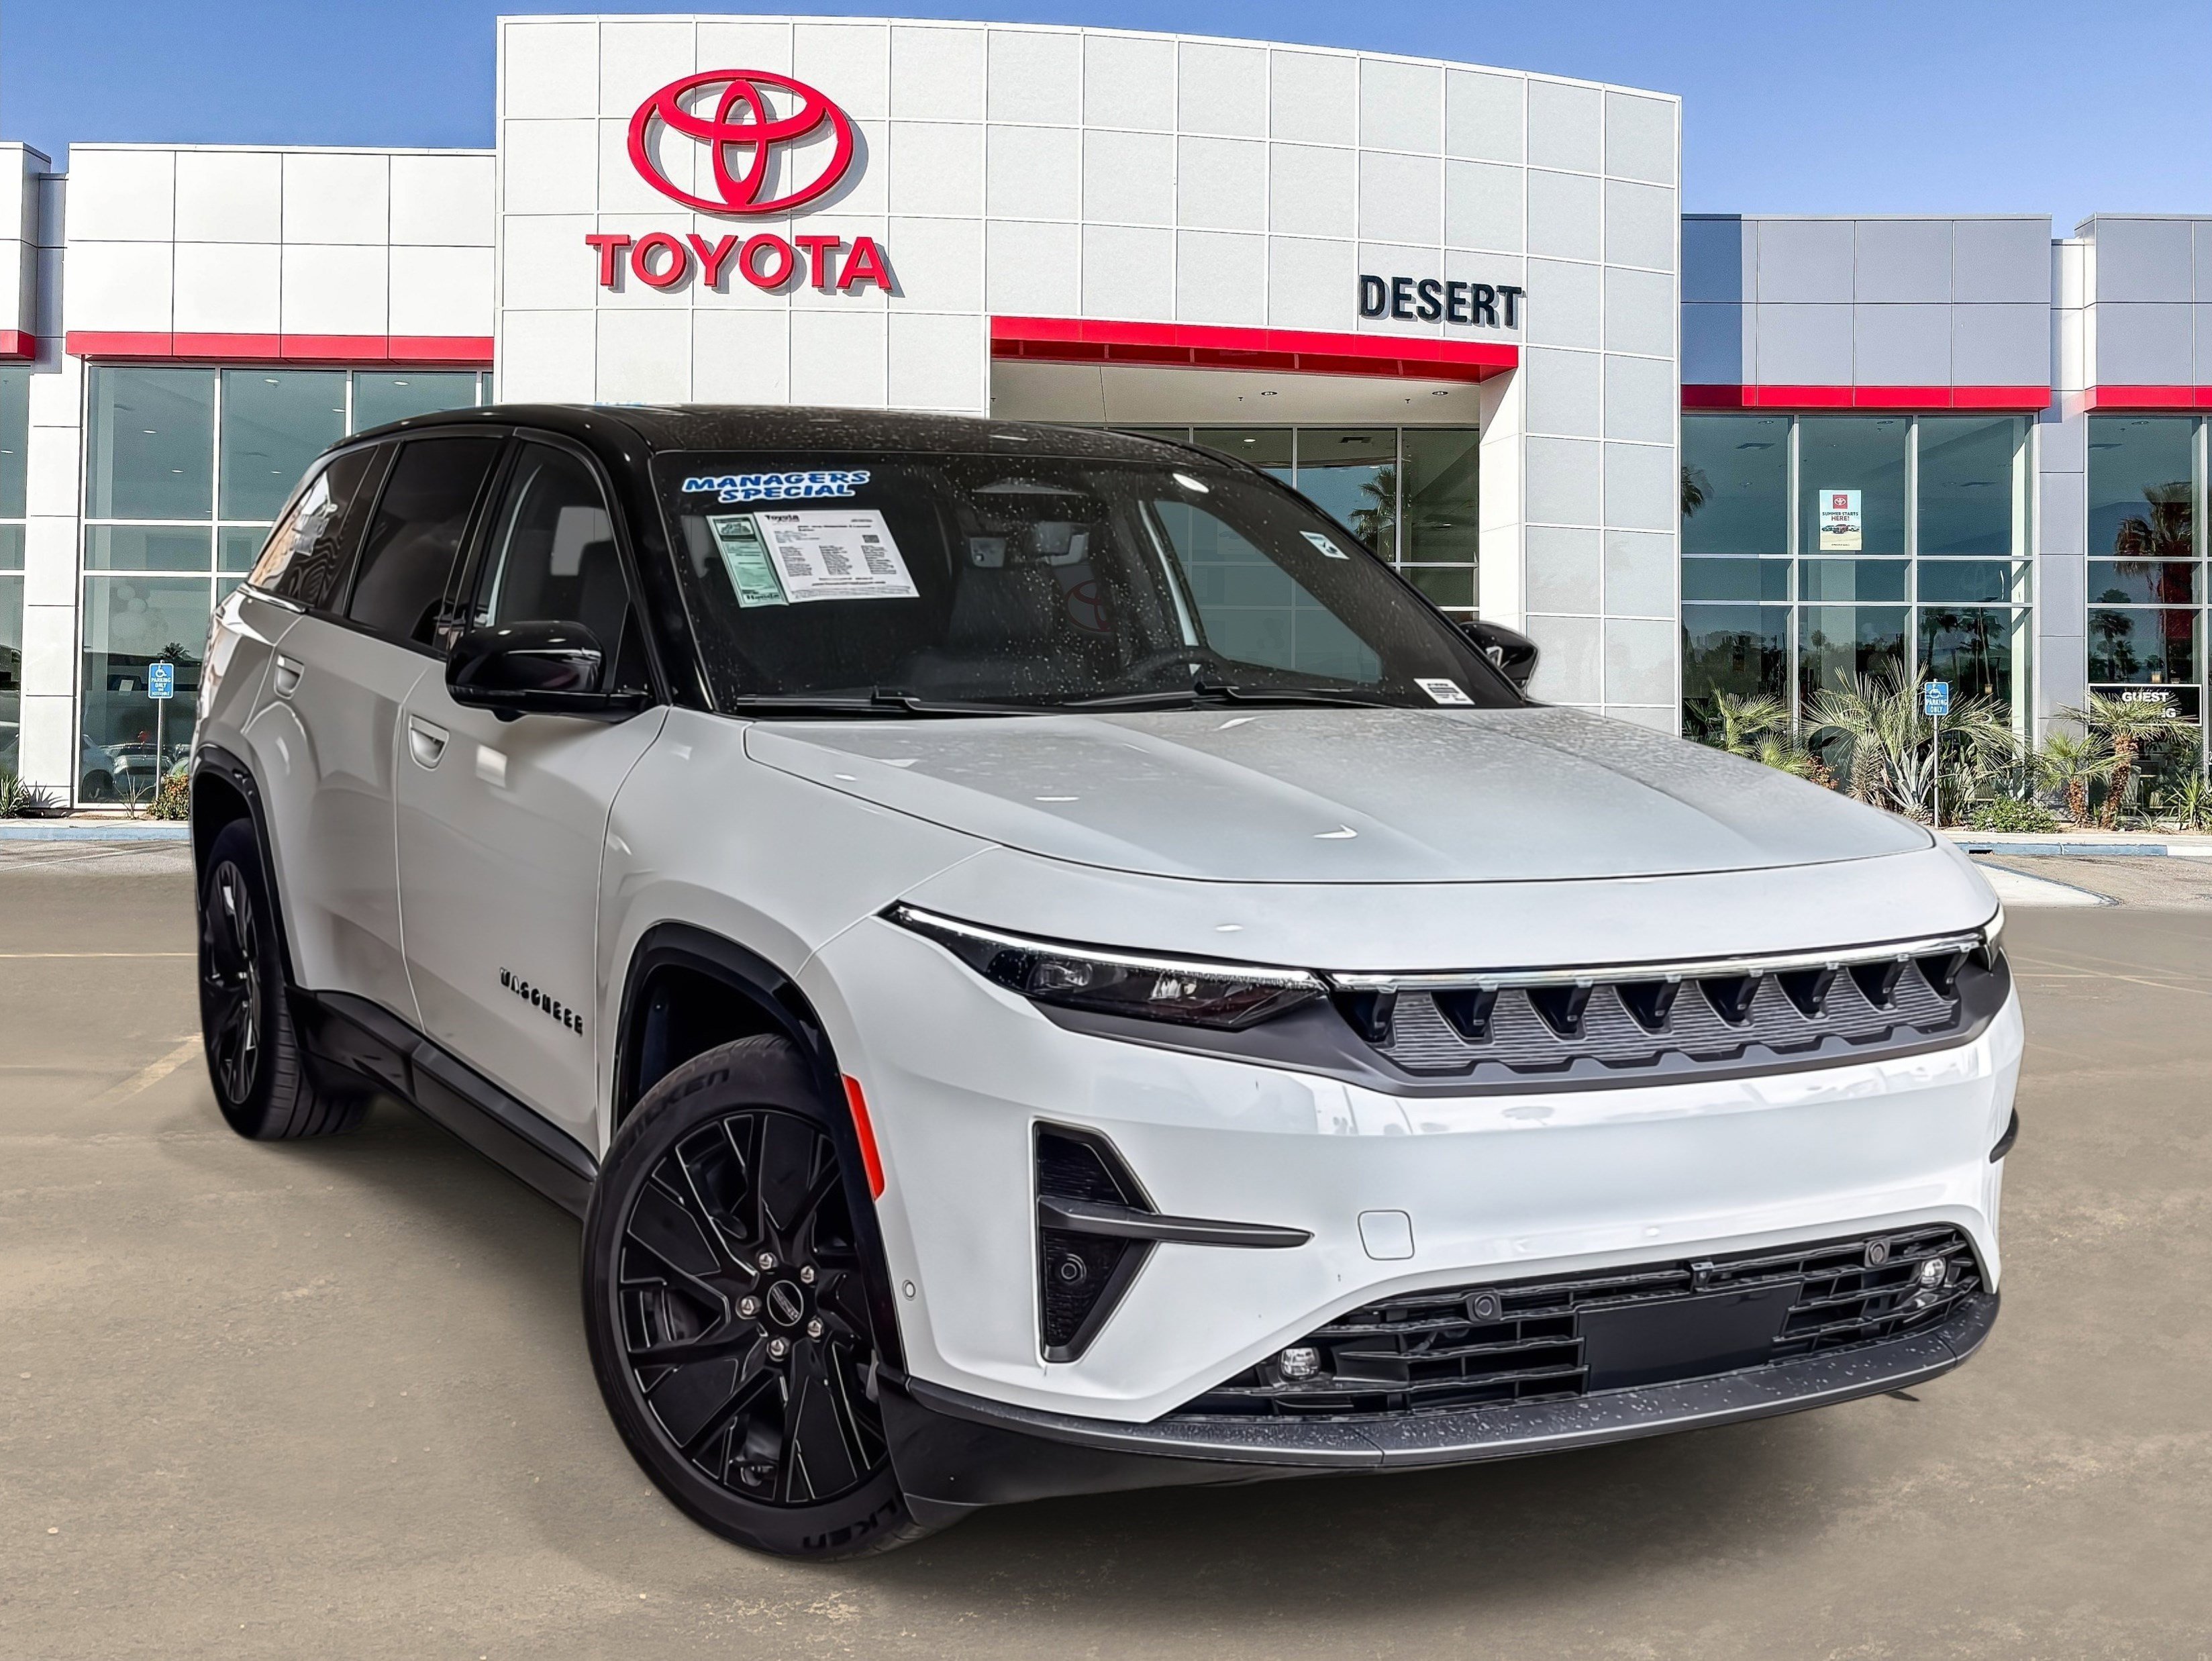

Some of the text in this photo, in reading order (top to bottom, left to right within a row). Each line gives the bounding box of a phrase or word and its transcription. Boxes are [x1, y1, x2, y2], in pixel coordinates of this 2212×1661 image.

[586, 232, 893, 290] TOYOTA
[1359, 274, 1522, 326] DESERT
[683, 471, 870, 491] MANAGERS
[720, 484, 855, 501] SPECIAL
[2121, 691, 2169, 702] GUEST
[803, 1489, 904, 1548] LKEN
